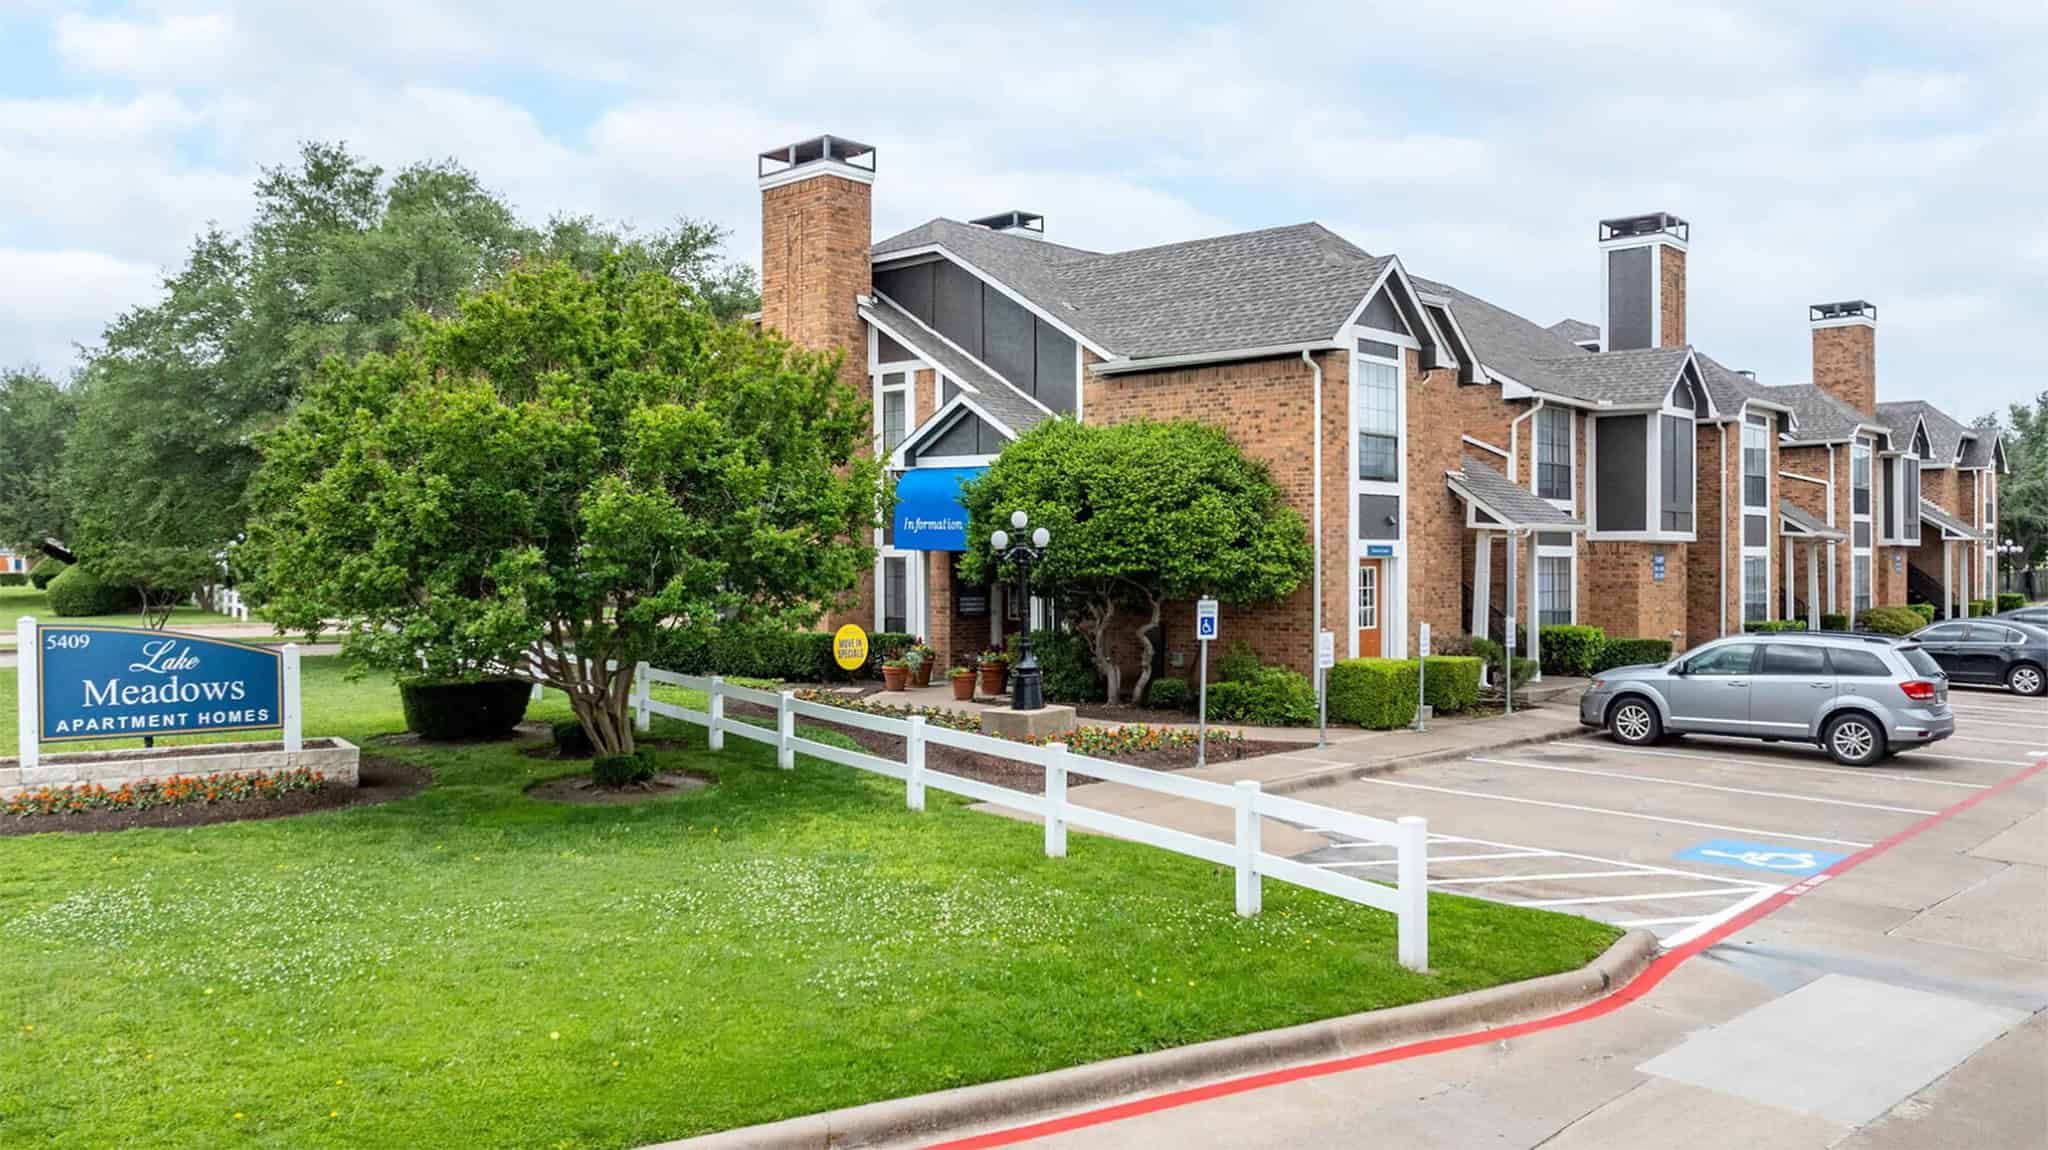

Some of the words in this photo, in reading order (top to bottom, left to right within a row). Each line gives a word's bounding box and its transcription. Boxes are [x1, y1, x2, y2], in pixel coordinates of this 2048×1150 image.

[904, 517, 963, 533] Information
[47, 635, 90, 649] 5409
[129, 640, 200, 673] Lake
[82, 676, 245, 707] Meadows
[56, 713, 188, 732] APARTMENT
[198, 709, 269, 724] HOMES
